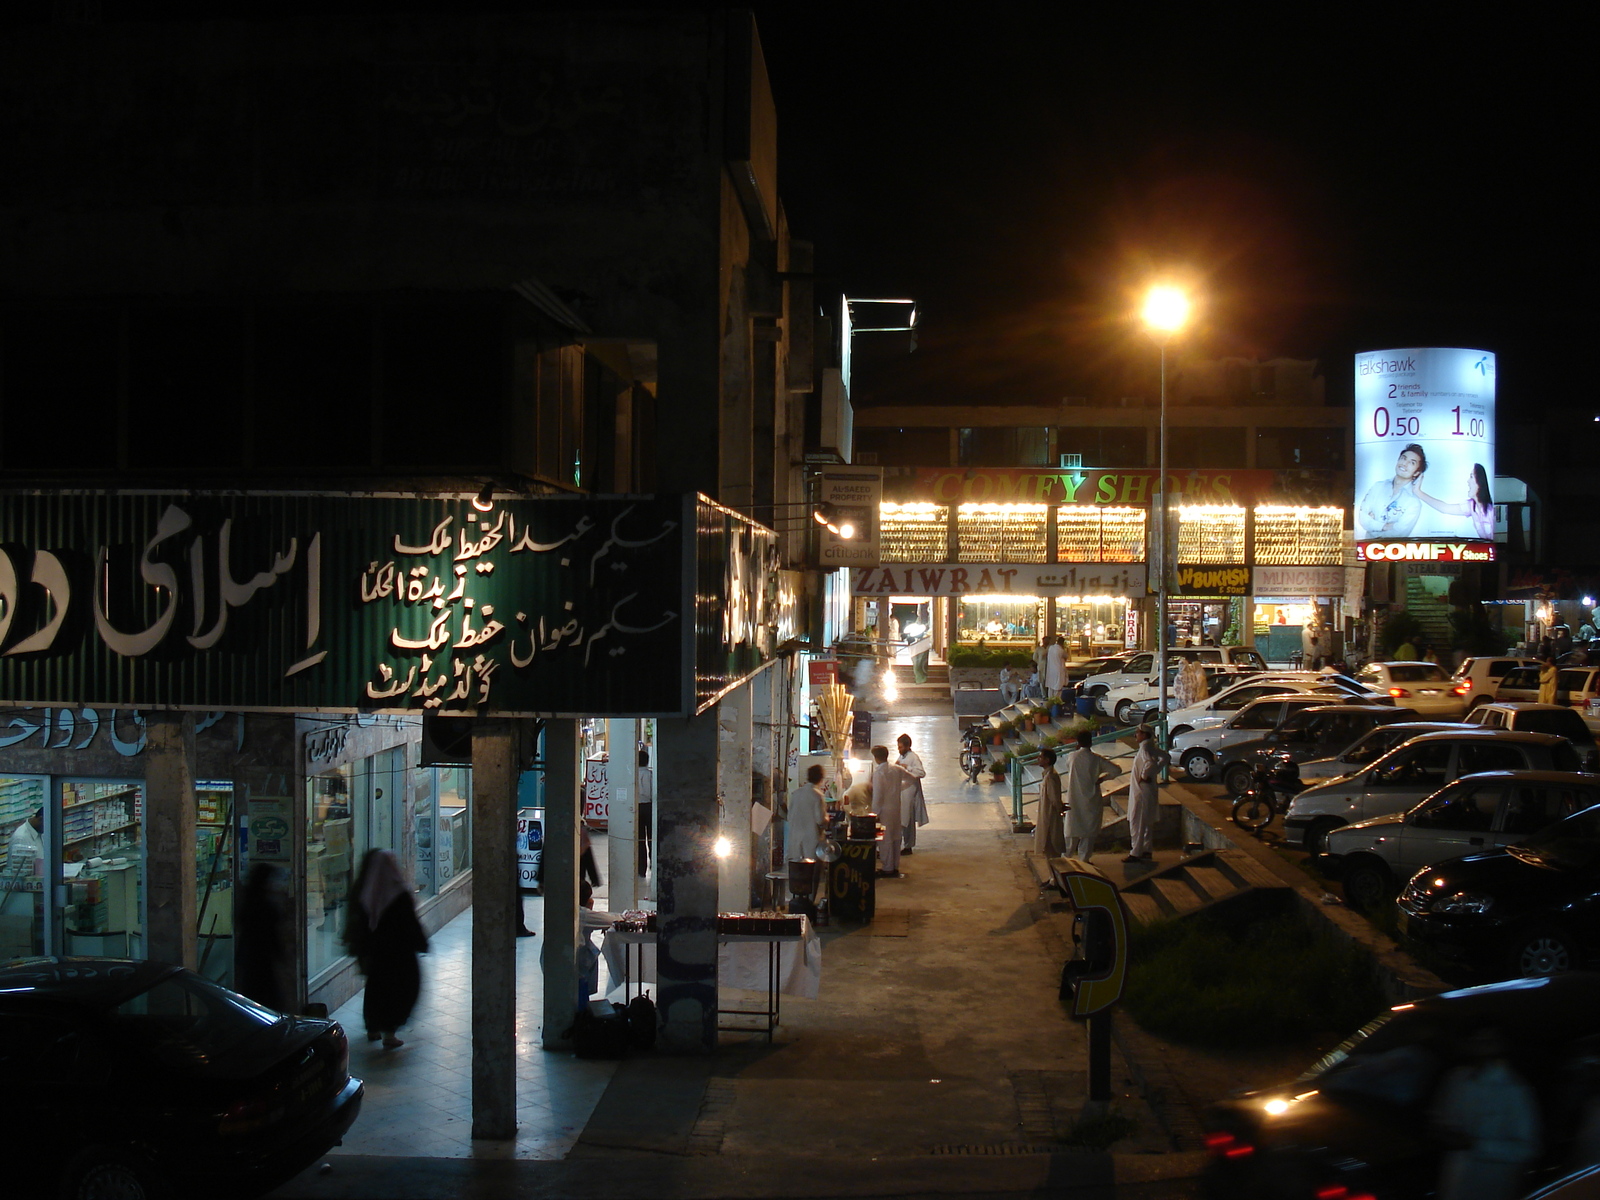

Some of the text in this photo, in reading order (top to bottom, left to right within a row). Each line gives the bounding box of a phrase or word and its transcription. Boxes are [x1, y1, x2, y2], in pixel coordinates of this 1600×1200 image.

[1359, 356, 1416, 376] talkshawk
[1388, 384, 1397, 398] 2
[1407, 390, 1429, 398] family
[933, 473, 1088, 503] COMFY
[1095, 474, 1233, 503] SHOES
[394, 515, 454, 555] ملک
[590, 504, 678, 588] حکیم
[825, 546, 874, 559] citibank
[1365, 543, 1489, 560] COMFY Shoes
[855, 567, 1018, 595] ZAIWRAT
[1036, 567, 1131, 596] زیورات
[1226, 586, 1247, 594] SONS
[1263, 571, 1341, 585] MUNCHIES
[391, 610, 451, 651] ملک
[510, 601, 584, 669] رضوان
[584, 592, 679, 669] حکیم
[840, 844, 873, 860] HOT
